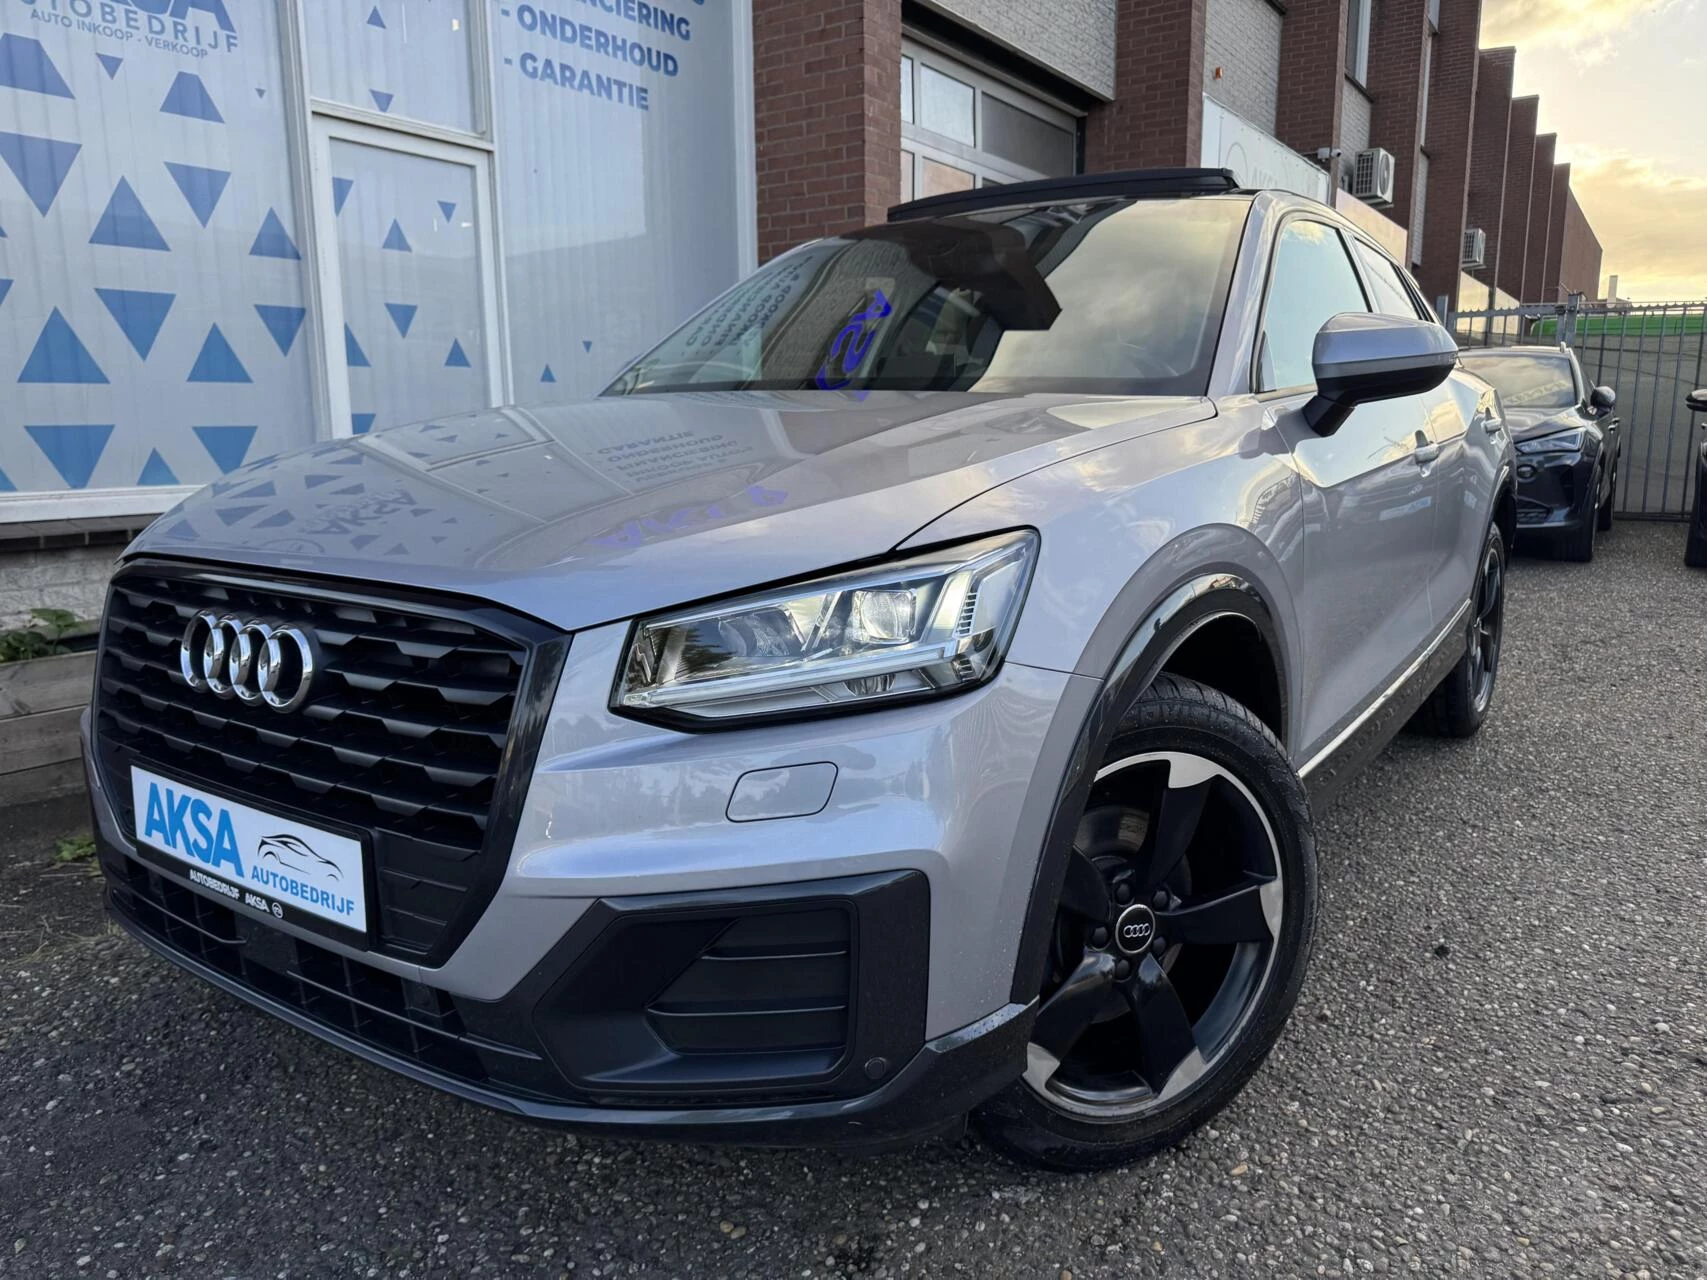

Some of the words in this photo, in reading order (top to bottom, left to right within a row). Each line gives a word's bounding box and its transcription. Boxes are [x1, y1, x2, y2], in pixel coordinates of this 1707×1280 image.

[31, 8, 73, 28] AUTO
[77, 18, 133, 42] INKOOP
[145, 35, 208, 59] VERKOOP
[144, 782, 245, 878] AKSA
[245, 892, 271, 913] AKSA
[251, 864, 355, 916] AUTOBEDRIJF
